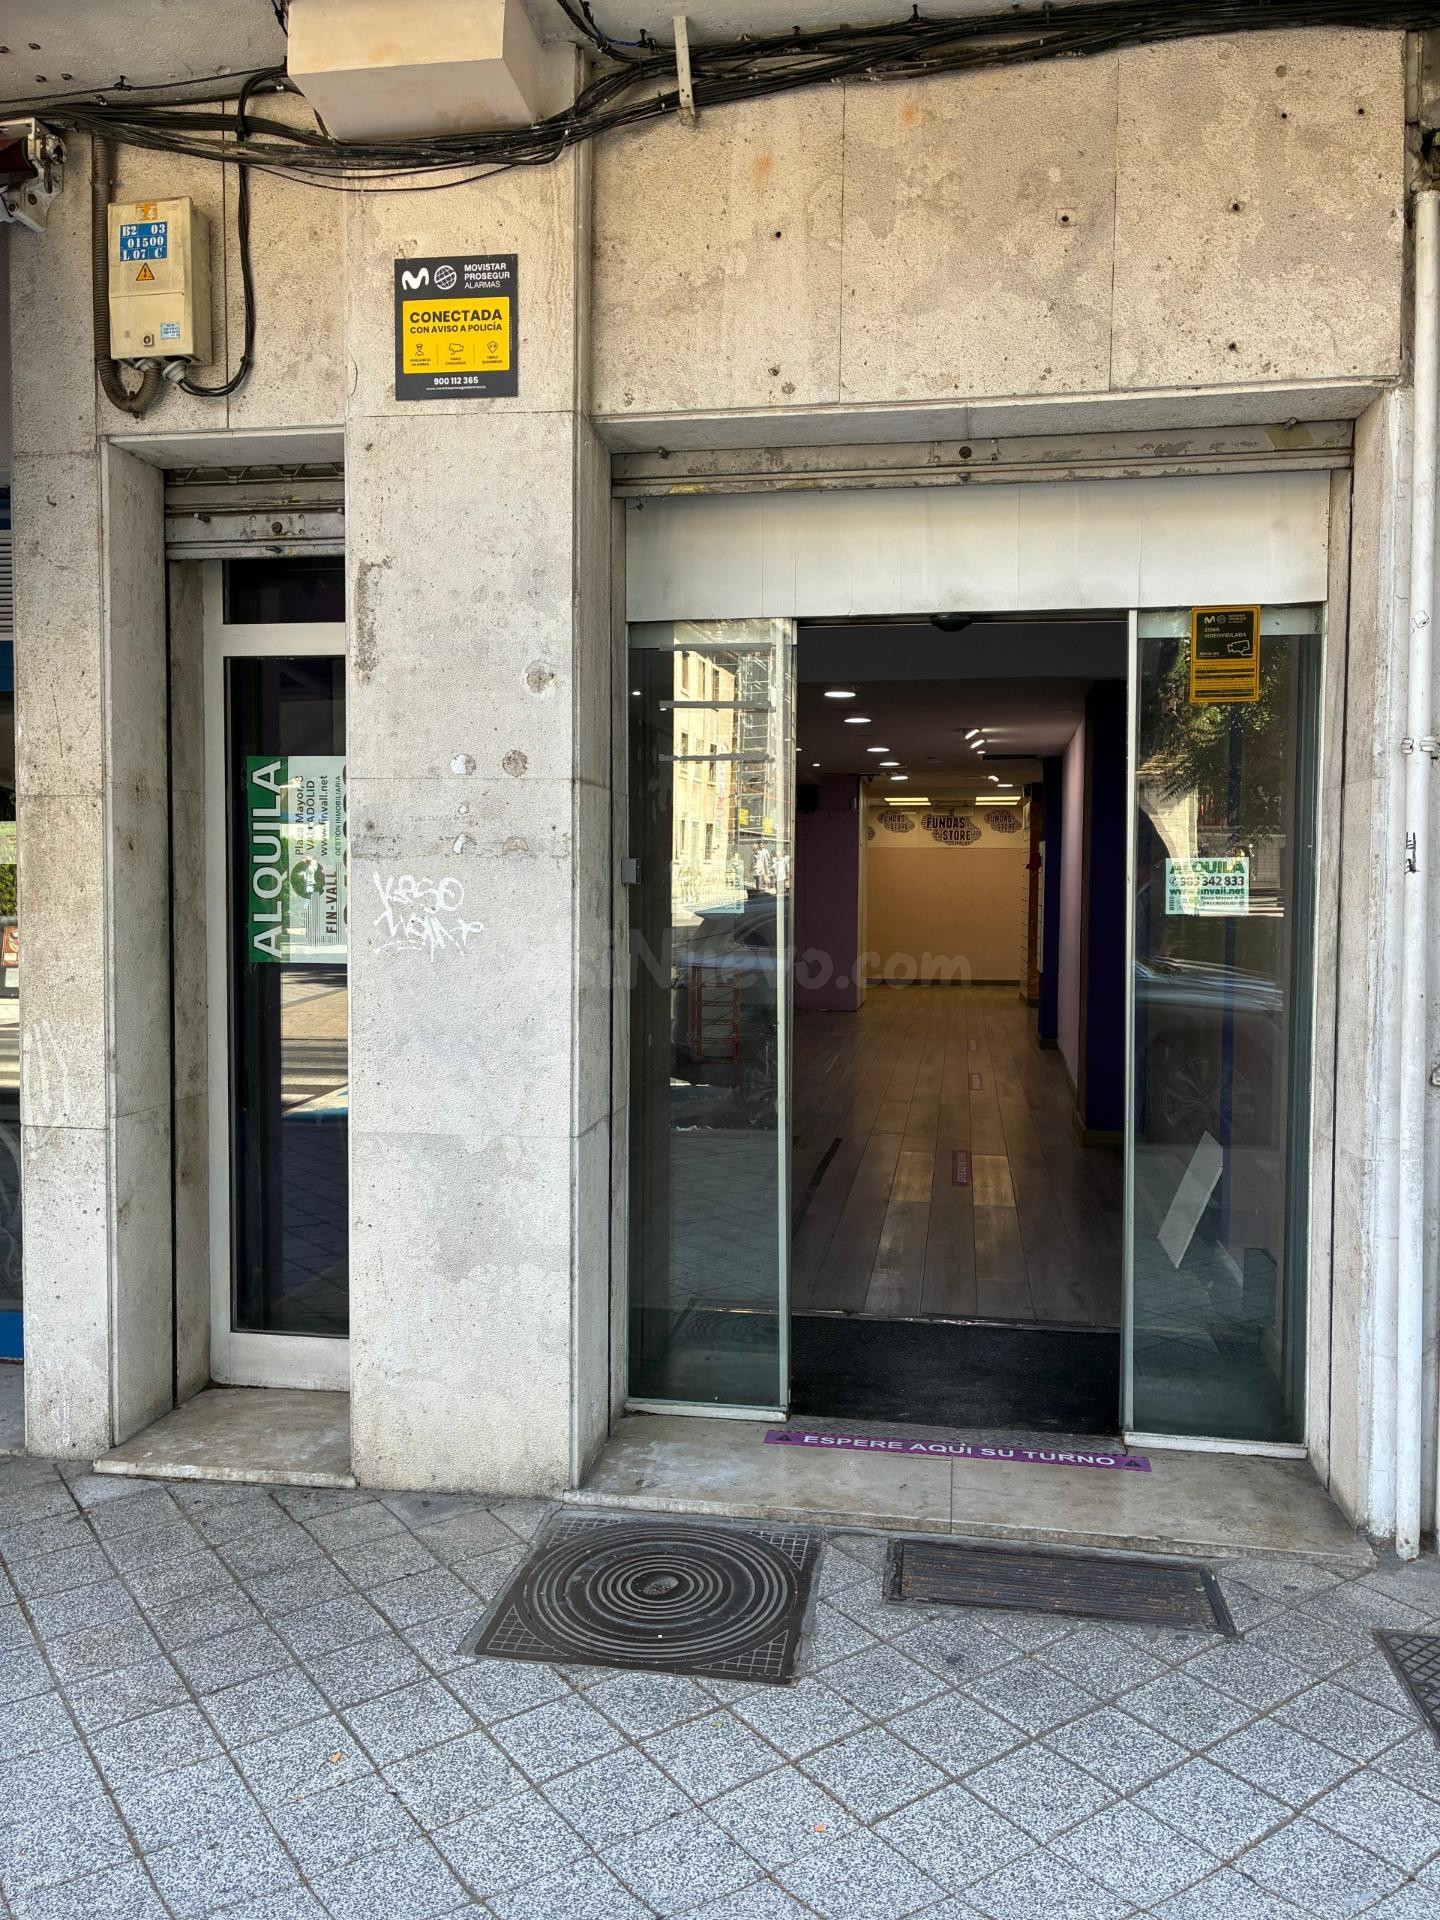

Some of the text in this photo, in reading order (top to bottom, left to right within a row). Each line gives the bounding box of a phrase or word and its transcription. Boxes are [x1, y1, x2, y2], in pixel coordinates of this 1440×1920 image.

[122, 224, 166, 236] B2 03
[127, 236, 164, 248] 01500
[122, 248, 162, 261] L 07 C
[464, 263, 507, 272] MOVISTAR
[464, 271, 511, 281] PROSEGUR
[464, 280, 501, 289] ALARMAS
[409, 309, 502, 323] CONECTADA
[410, 322, 502, 334] CON AVISO A POLICÍA
[434, 376, 479, 386] 900 112 365
[295, 785, 306, 823] Mayor,
[926, 817, 966, 829] FUNDAS
[943, 829, 971, 841] STORE
[252, 760, 288, 959] ALQUILA
[1202, 876, 1222, 886] 342
[1224, 876, 1244, 886] 833
[326, 871, 338, 934] FIN-VALL
[804, 1435, 902, 1449] ESPERE
[981, 1448, 1014, 1457] SU
[1022, 1450, 1116, 1466] TURNO
